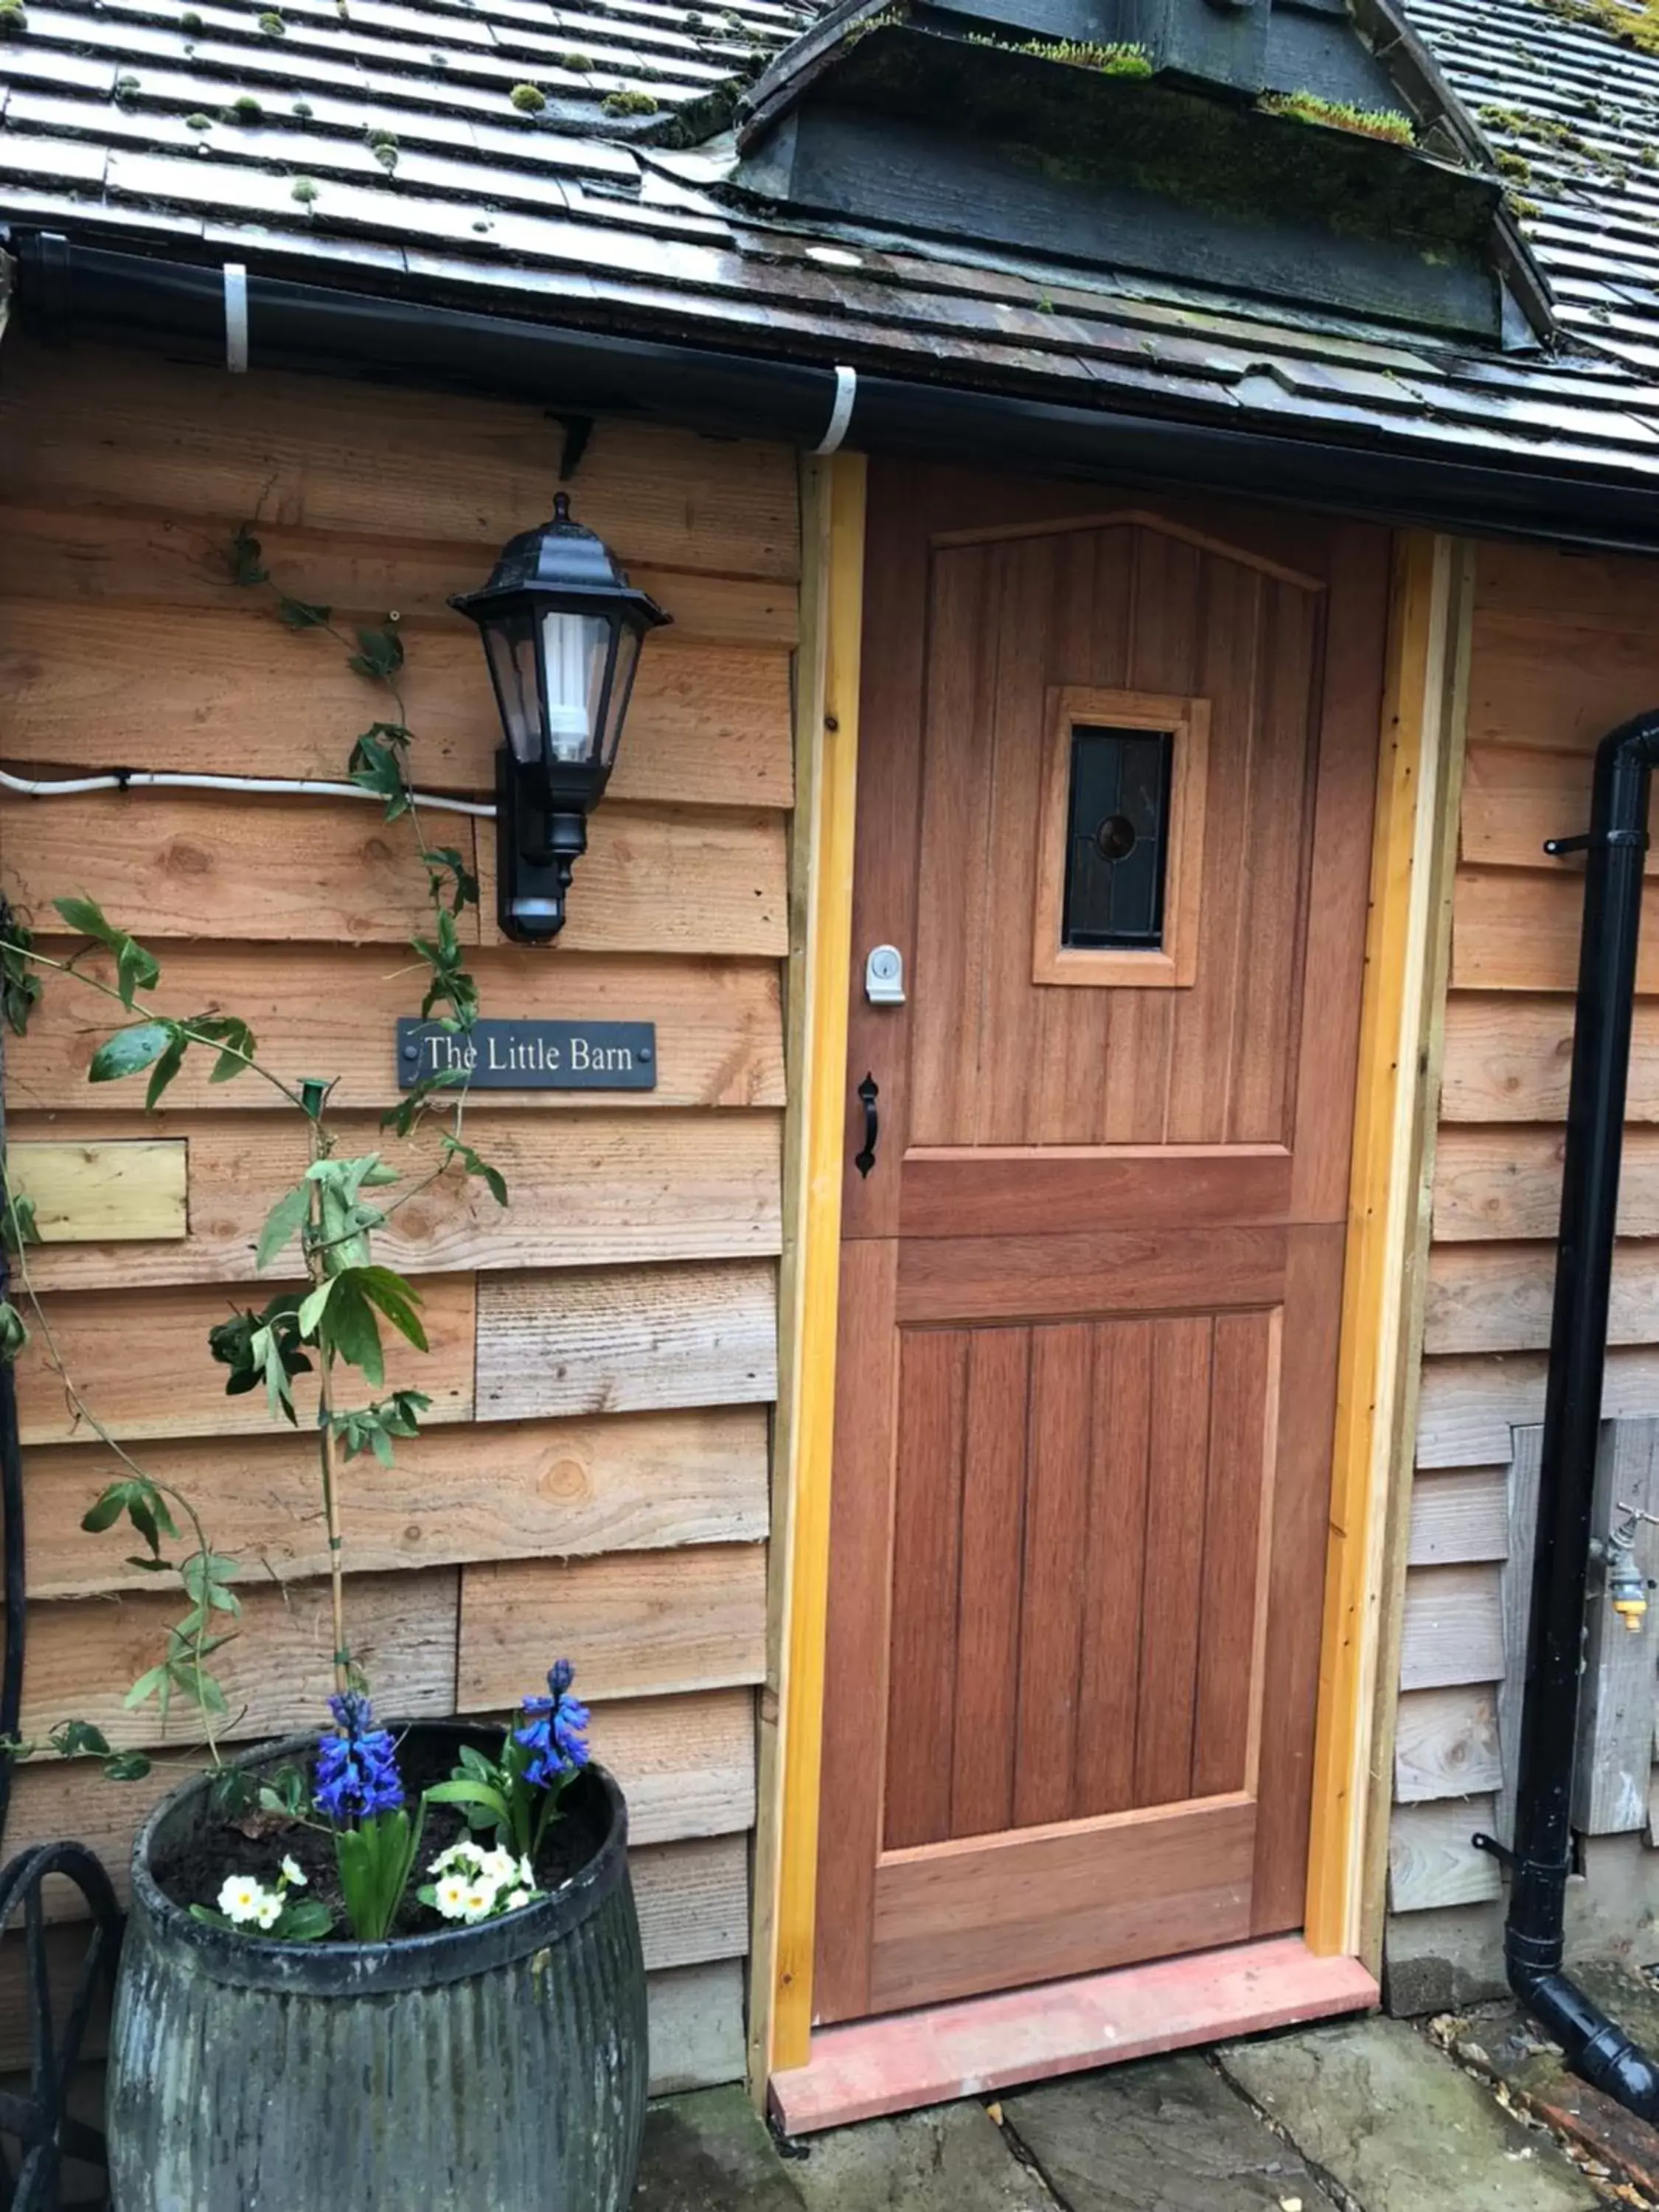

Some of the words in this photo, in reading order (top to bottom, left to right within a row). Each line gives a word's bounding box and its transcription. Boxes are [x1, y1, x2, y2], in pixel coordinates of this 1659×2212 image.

[425, 1037, 478, 1070] The
[487, 1037, 560, 1070] Little
[570, 1038, 633, 1071] Barn
